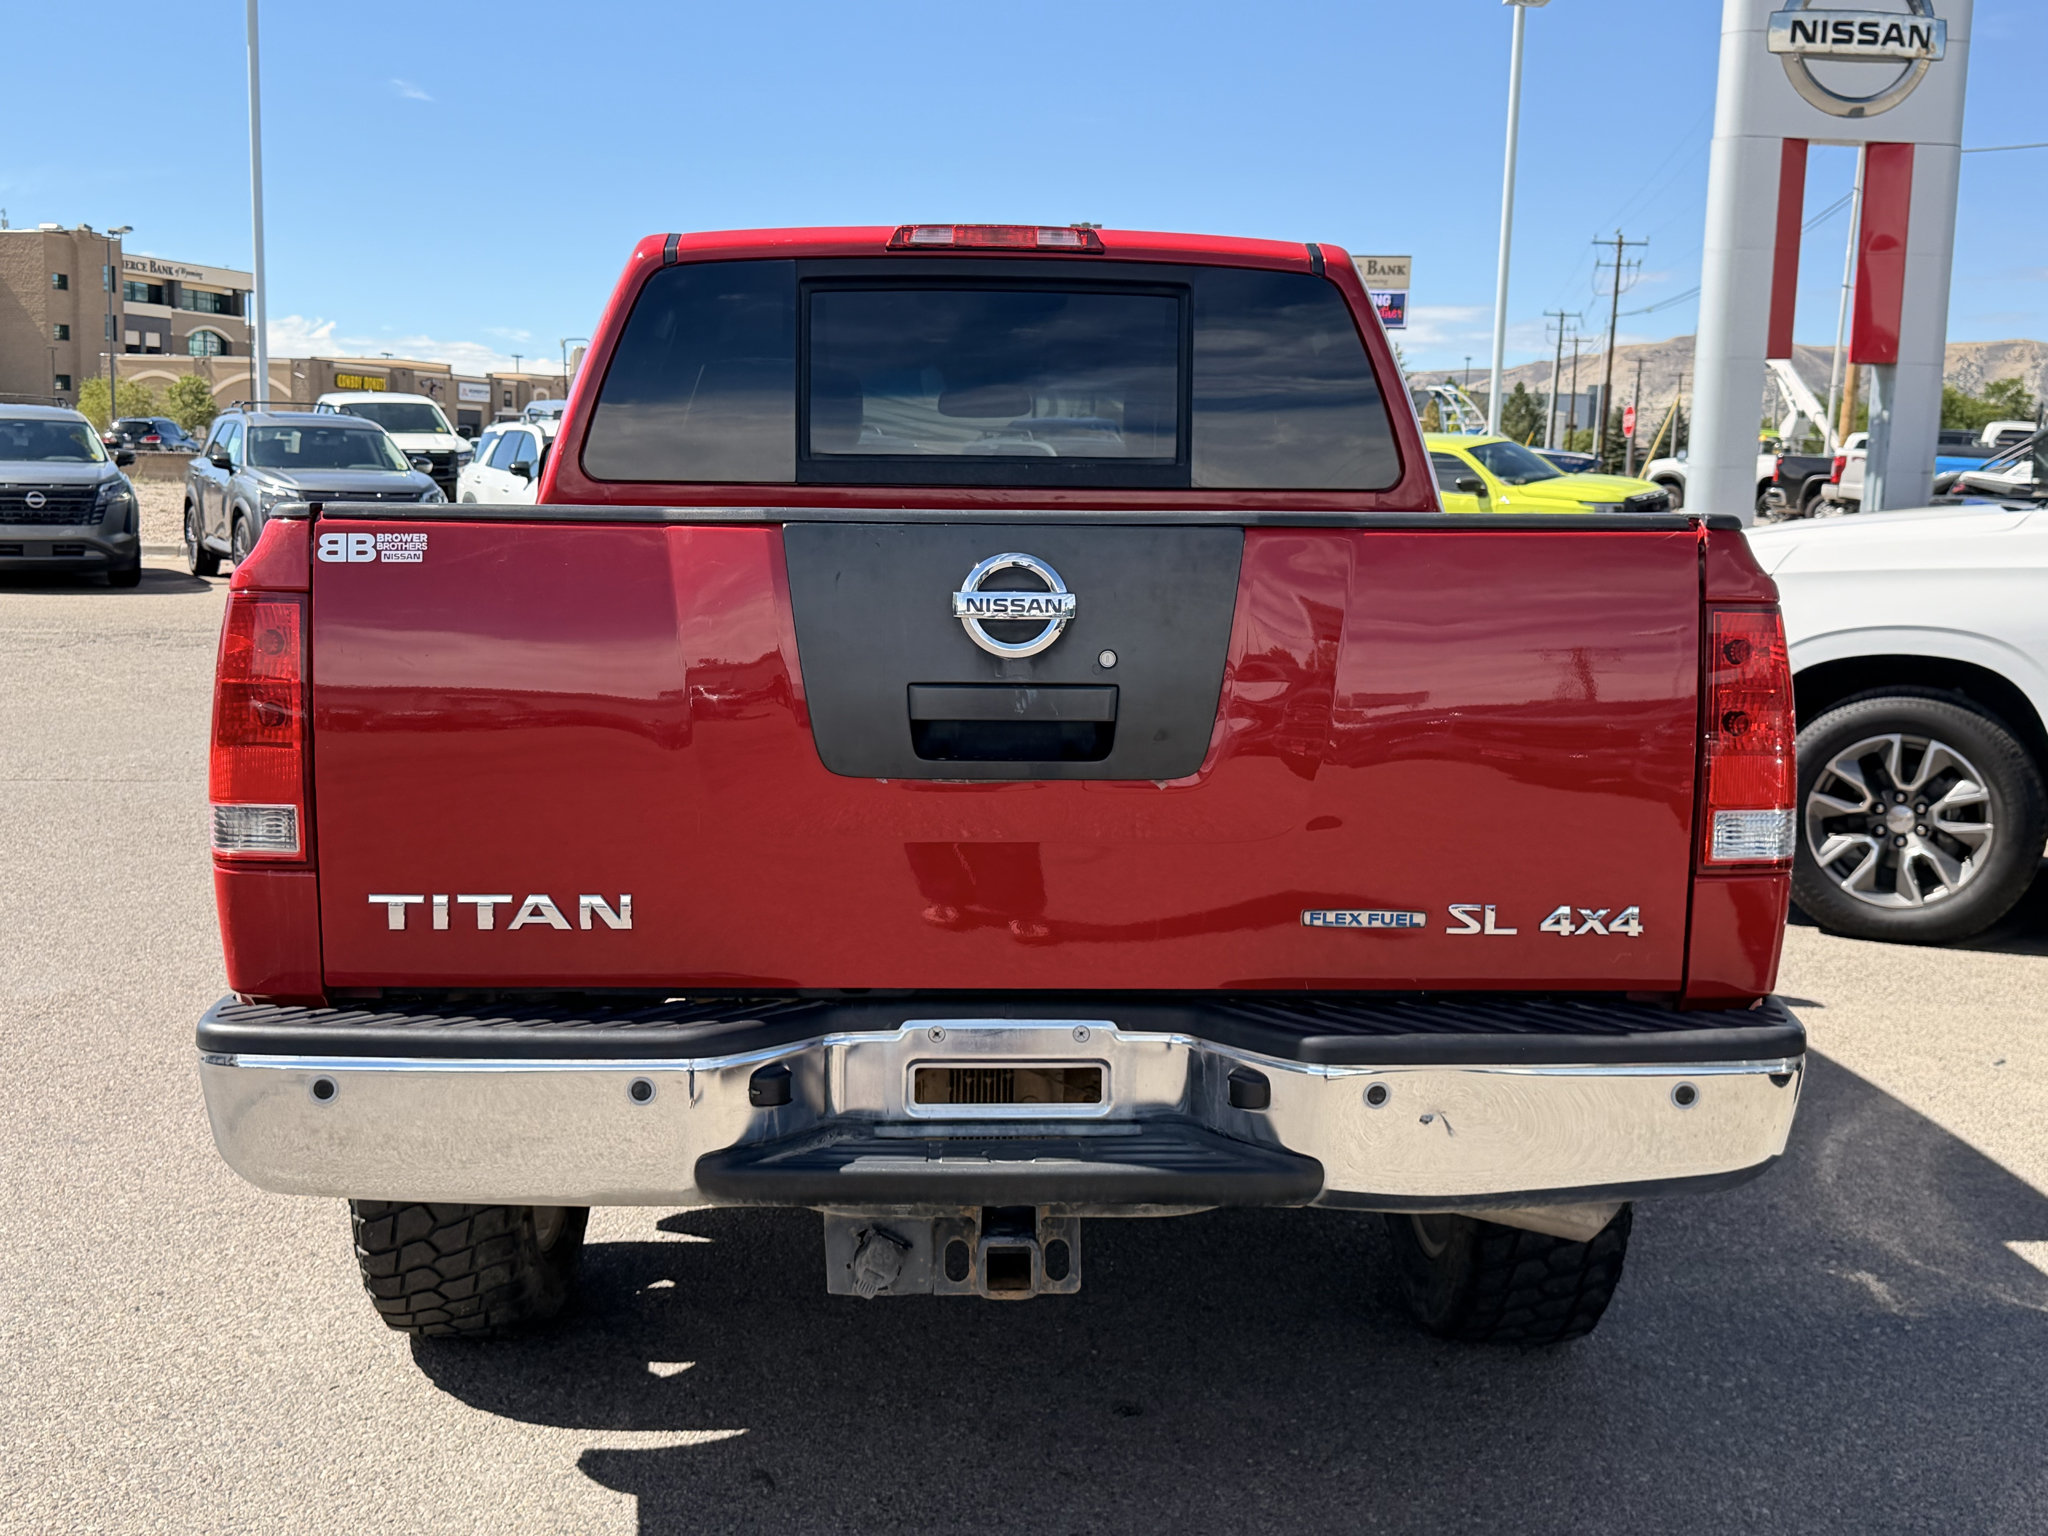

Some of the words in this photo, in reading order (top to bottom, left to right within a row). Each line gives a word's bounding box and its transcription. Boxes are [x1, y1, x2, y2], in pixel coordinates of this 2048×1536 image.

[1790, 20, 1931, 49] NISSAN
[123, 260, 148, 272] ERCE
[1367, 260, 1406, 276] BANK
[376, 533, 428, 543] BROWER
[376, 542, 428, 551] BROTHERS
[966, 598, 1062, 613] NISSAN
[368, 894, 633, 930] TITAN
[1309, 912, 1363, 926] FLEX
[1367, 913, 1422, 928] FUEL
[1446, 904, 1518, 935] SL
